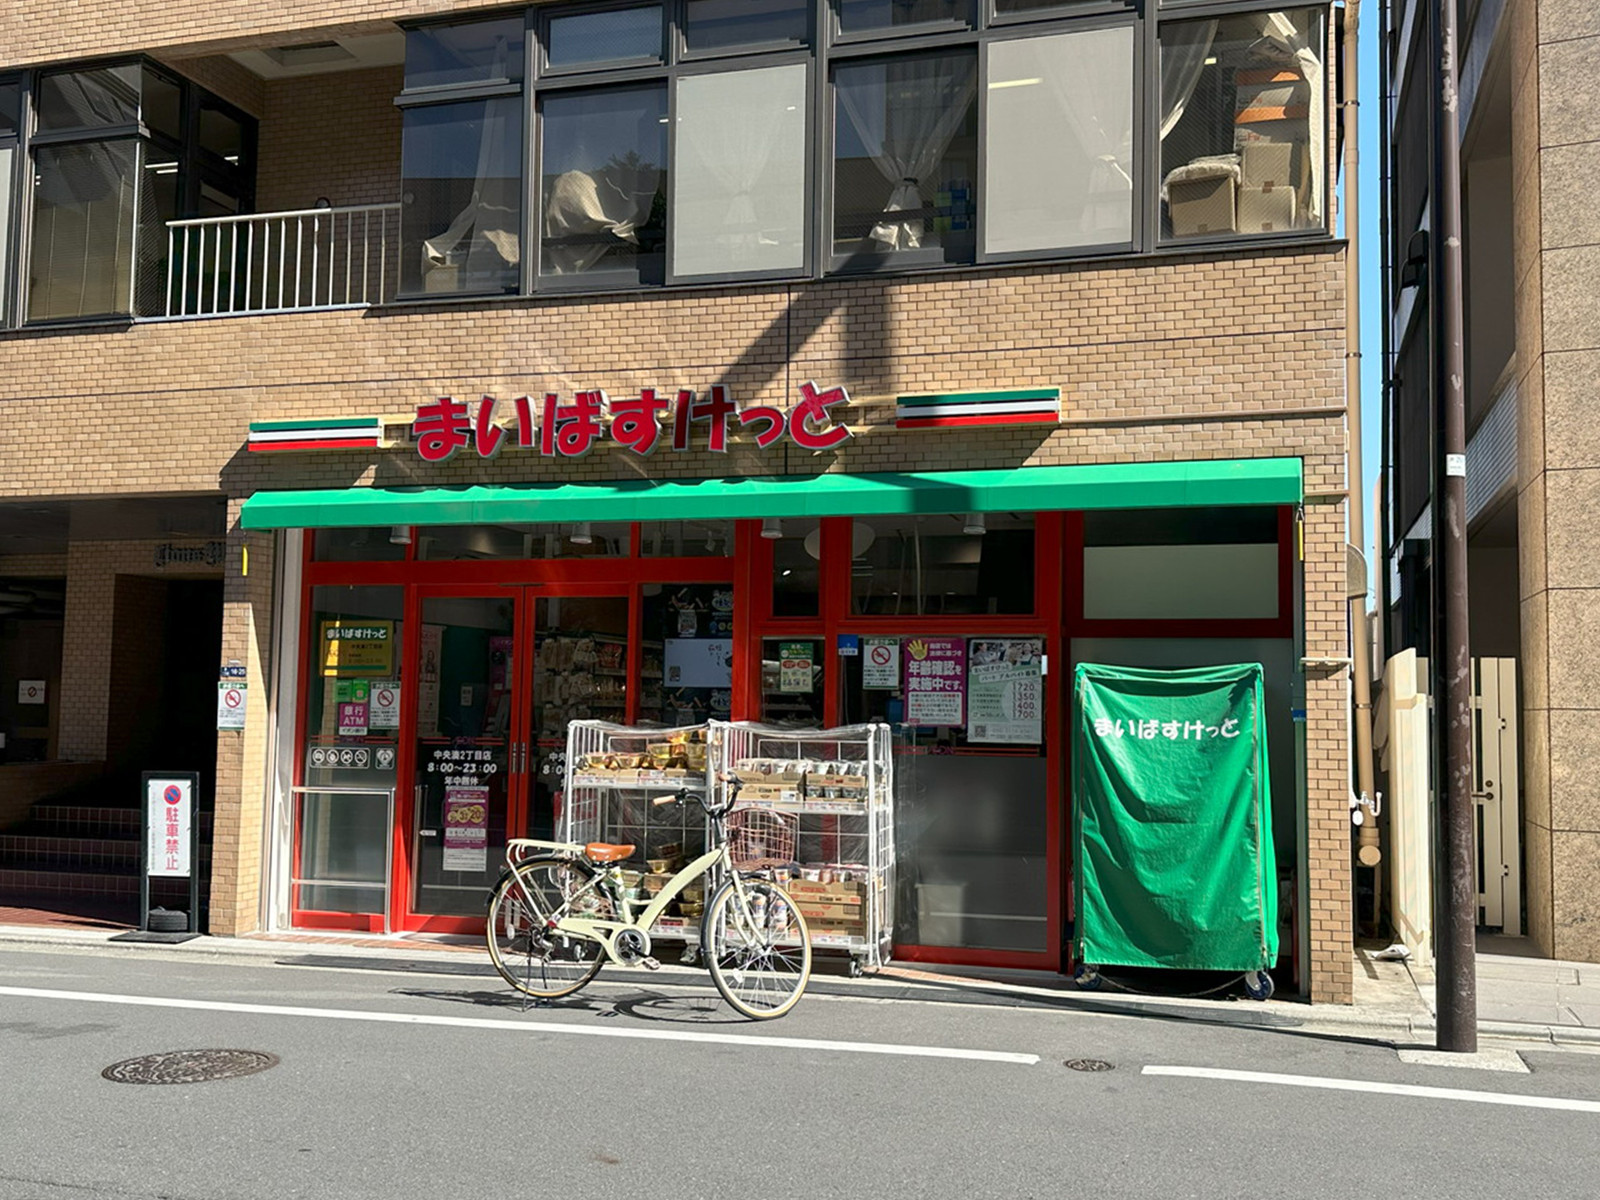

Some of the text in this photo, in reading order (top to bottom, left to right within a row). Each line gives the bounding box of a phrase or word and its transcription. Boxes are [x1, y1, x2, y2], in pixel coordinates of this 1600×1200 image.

[412, 379, 854, 462] まいばすけっと
[326, 628, 387, 639] まいばすけっと
[908, 660, 962, 676] 年齢確認を
[908, 677, 963, 691] 実施中です。
[344, 706, 363, 716] 銀行
[343, 716, 364, 725] ATM
[1094, 718, 1241, 740] まいばすけっと
[444, 776, 479, 786] 年中無休
[166, 807, 179, 870] 駐車禁止
